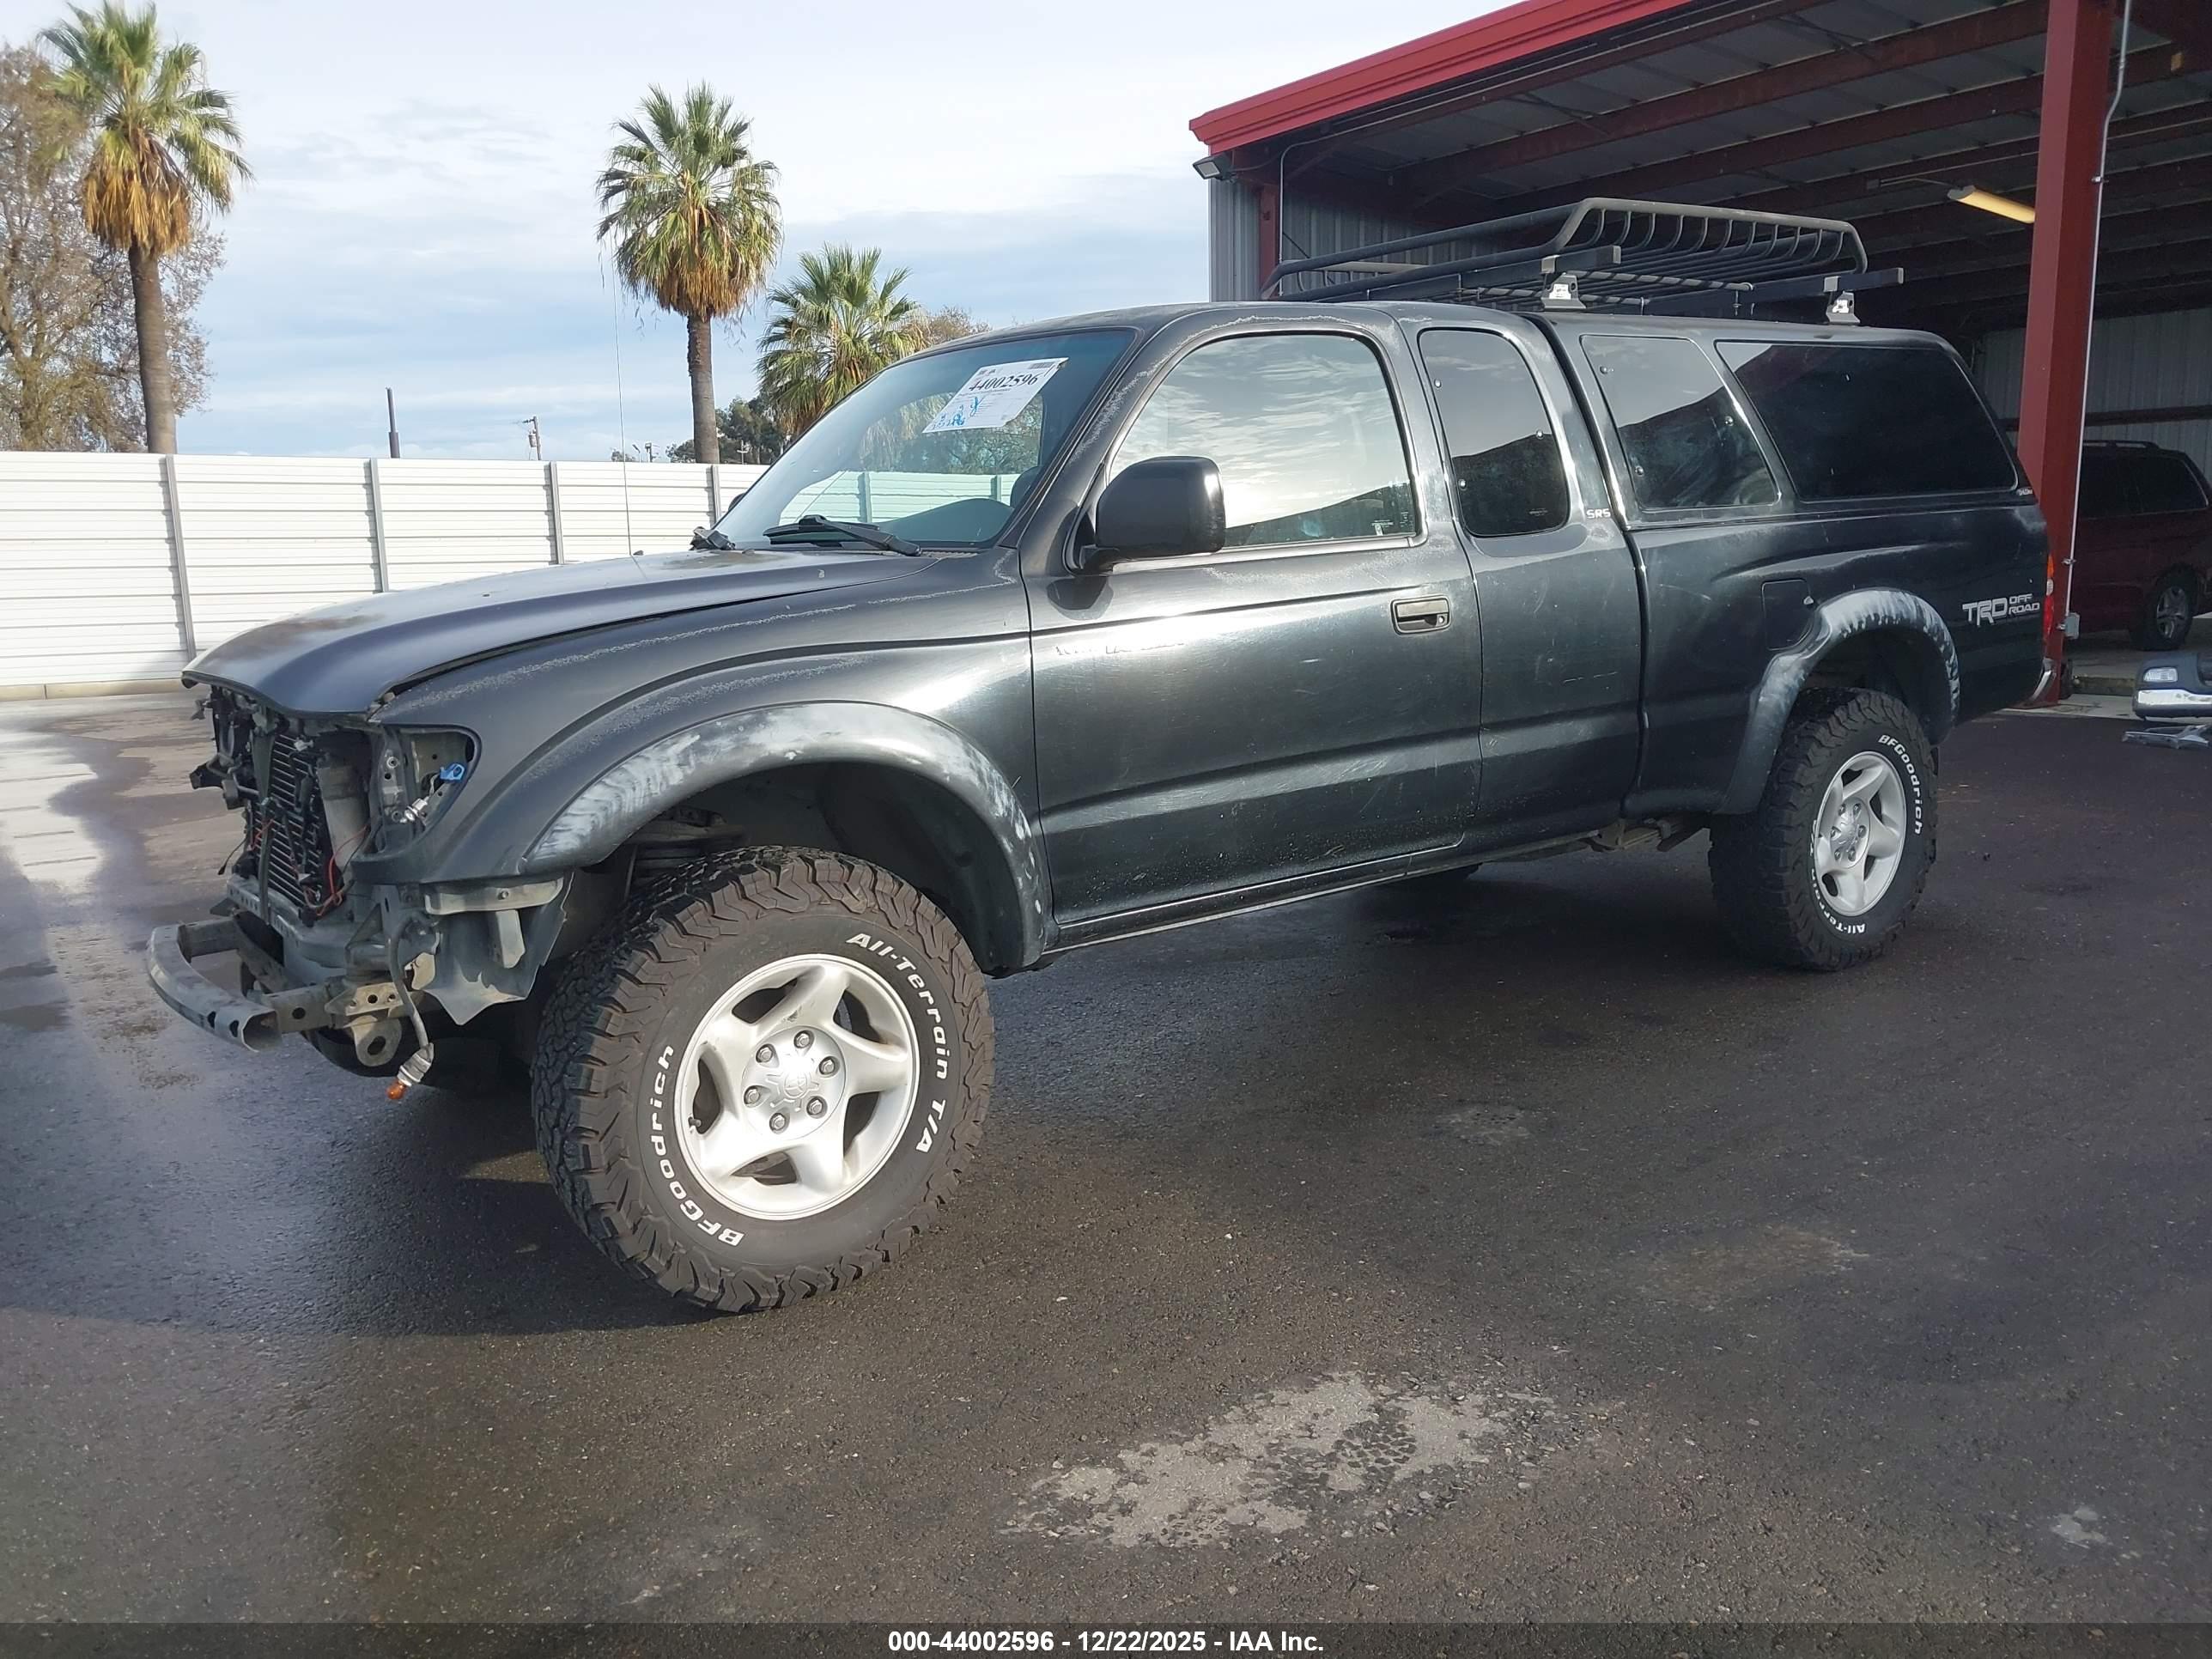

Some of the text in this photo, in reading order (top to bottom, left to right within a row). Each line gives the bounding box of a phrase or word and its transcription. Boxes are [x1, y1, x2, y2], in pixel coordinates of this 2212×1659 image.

[969, 372, 1042, 392] 44002596
[1586, 507, 1612, 519] SR5
[1961, 593, 2033, 626] TRD OFF
[2008, 602, 2040, 615] ROAD
[1878, 734, 1923, 835] BFGoodrich
[845, 933, 950, 1152] All-Terrain T/A
[650, 1045, 745, 1247] BFGoodrich
